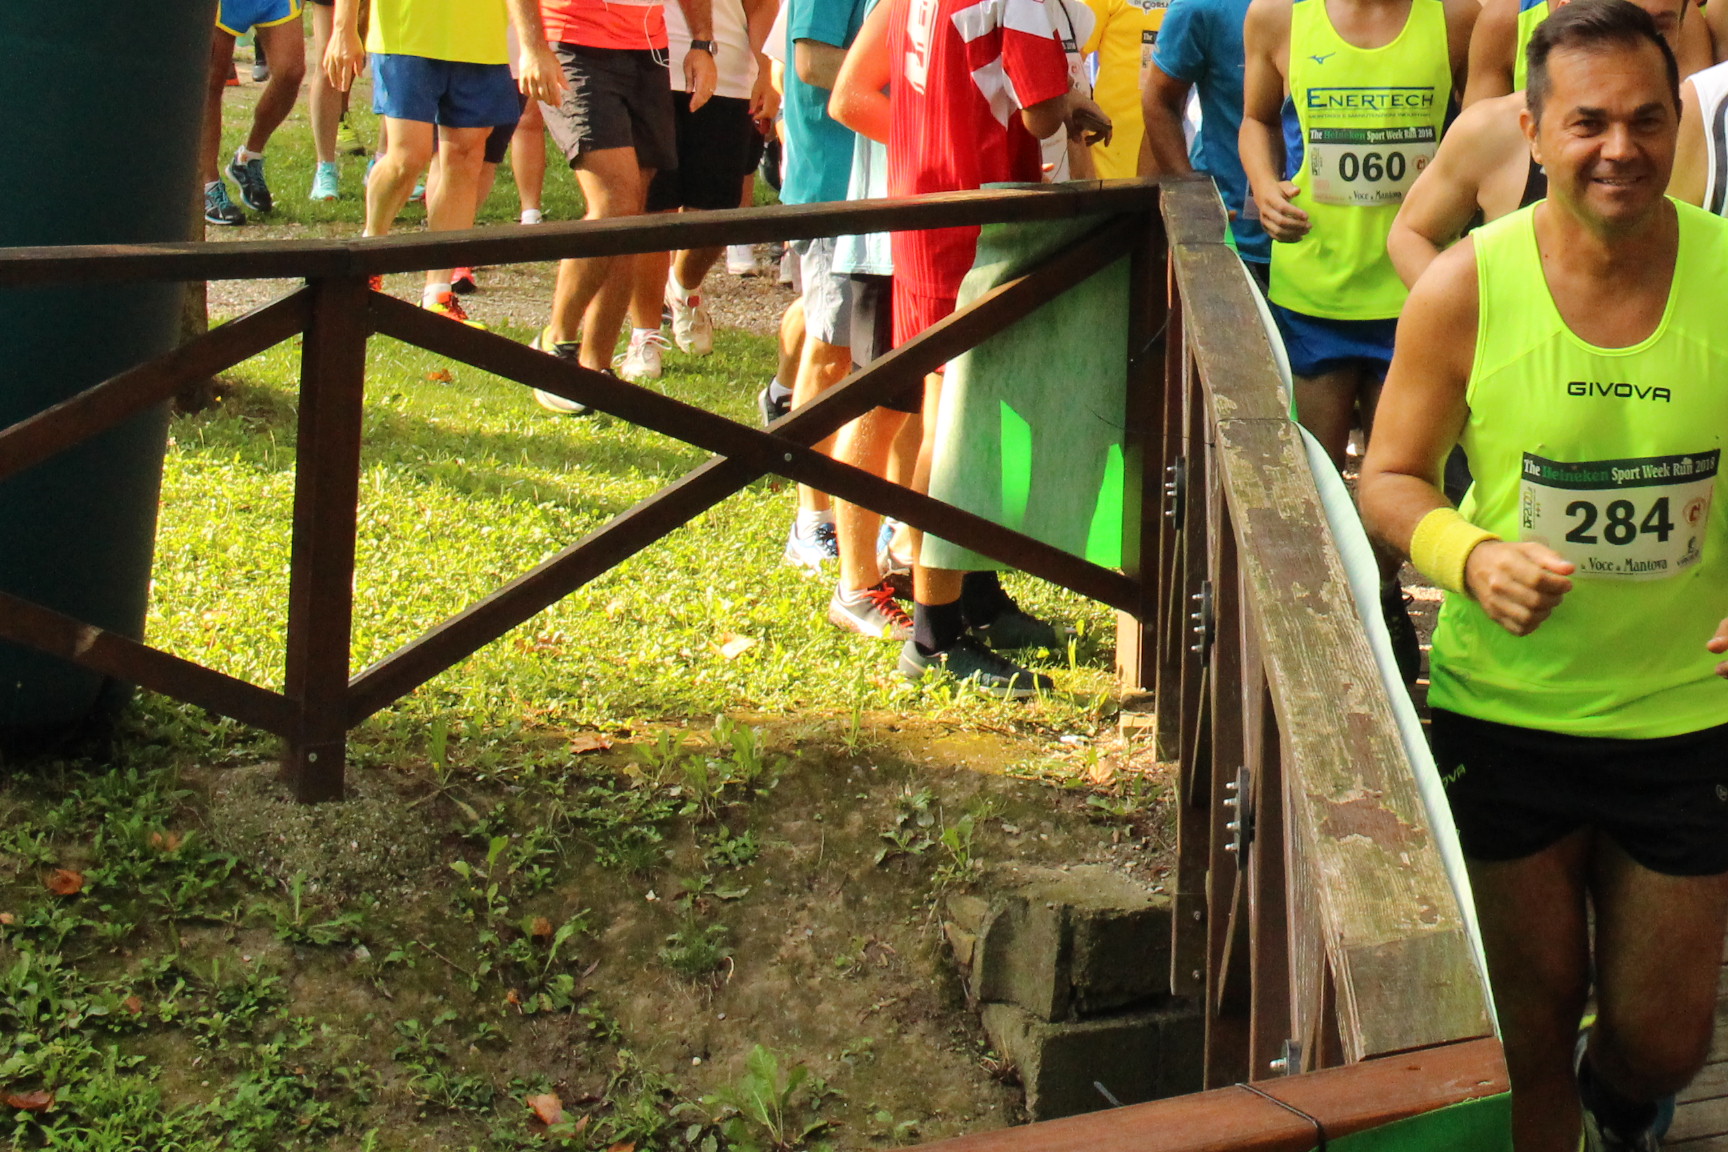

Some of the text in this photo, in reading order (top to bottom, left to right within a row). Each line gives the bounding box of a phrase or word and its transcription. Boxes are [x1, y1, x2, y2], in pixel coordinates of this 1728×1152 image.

[1307, 87, 1434, 110] ENERTECH
[1310, 129, 1322, 140] The
[1367, 130, 1385, 142] Sport
[1386, 129, 1403, 140] Week
[1418, 128, 1433, 138] 2018
[1339, 151, 1406, 182] 060
[1567, 381, 1671, 403] GIVOVA
[1524, 456, 1715, 484] The Heineken Sport Week Run 2018
[1565, 496, 1674, 546] 284
[1588, 557, 1614, 571] Voce
[1624, 558, 1668, 572] Mantova
